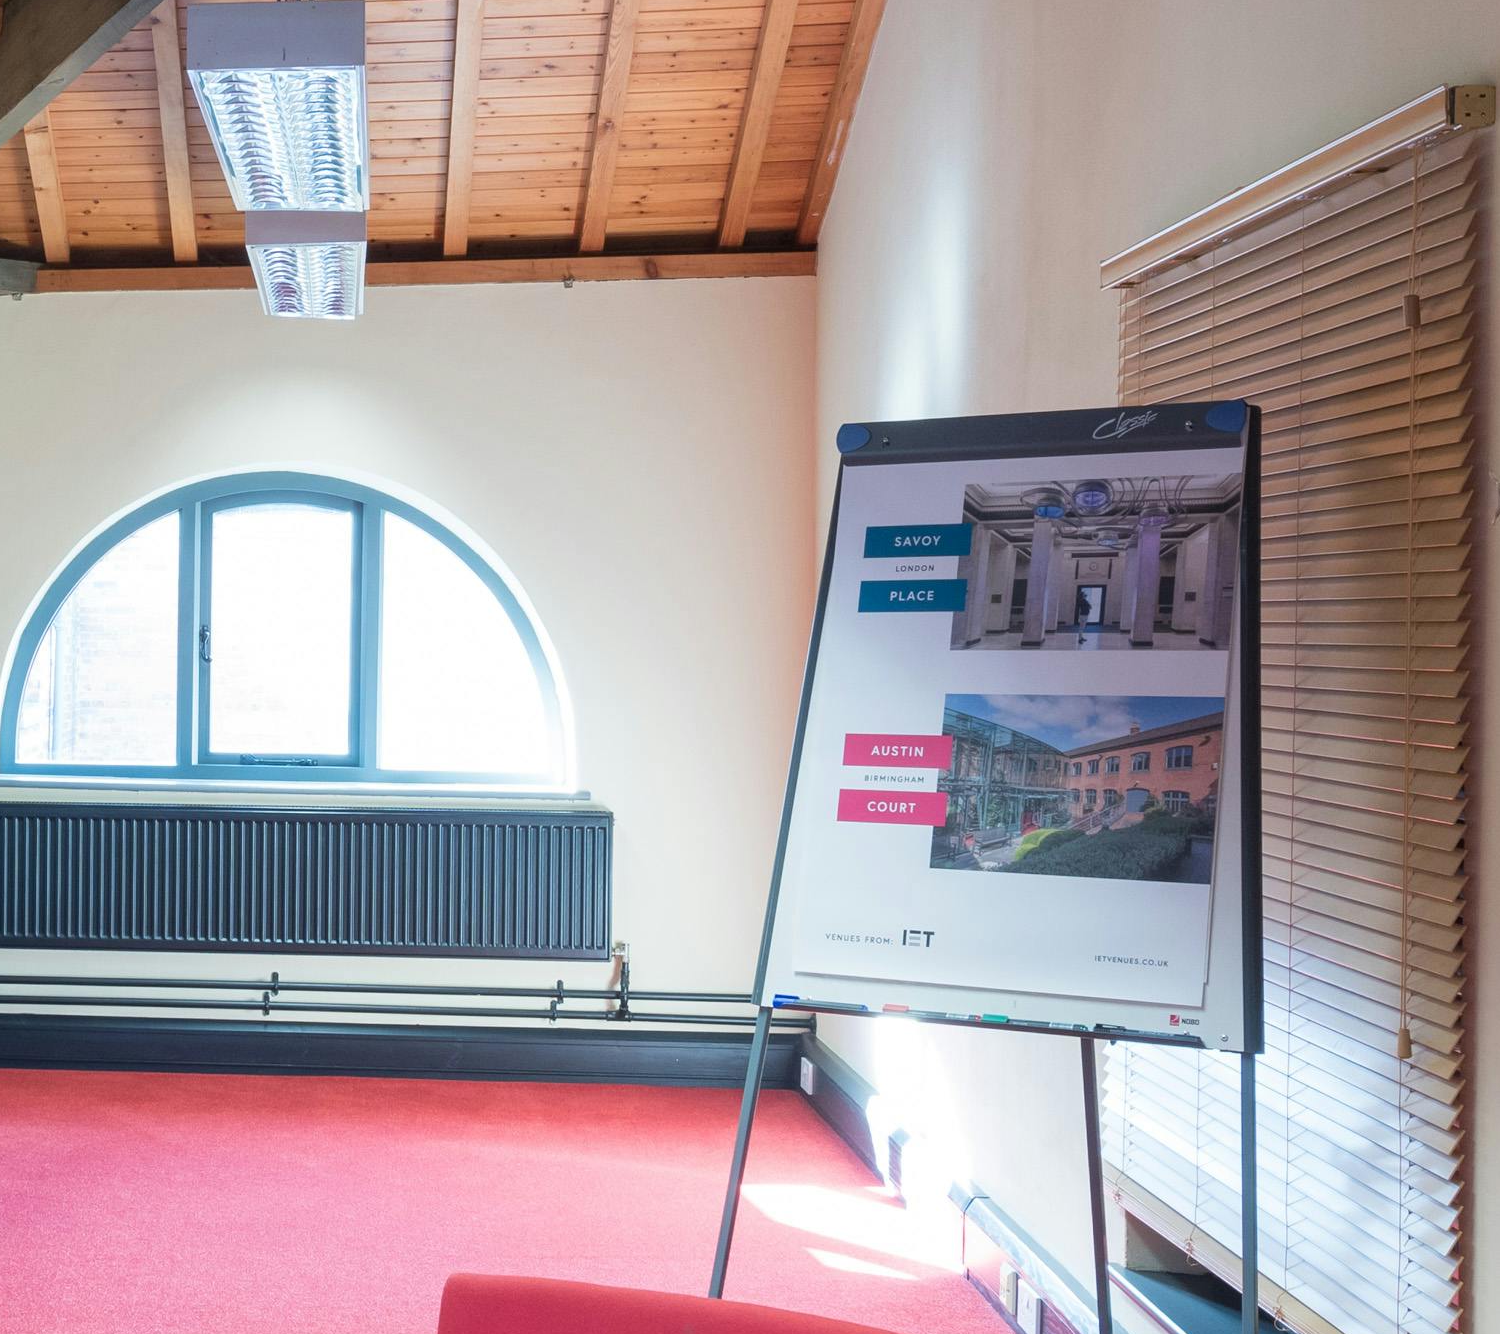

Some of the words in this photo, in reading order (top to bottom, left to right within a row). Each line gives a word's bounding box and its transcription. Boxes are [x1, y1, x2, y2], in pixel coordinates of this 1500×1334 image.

[1092, 410, 1159, 440] Classic
[894, 535, 941, 547] SAVOY
[895, 564, 935, 573] LONDON
[889, 590, 935, 602] PLACE
[870, 745, 924, 757] AUSTIN
[863, 774, 925, 784] BIRMINGHAM
[866, 801, 917, 813] COURT
[825, 932, 861, 943] VENUES
[864, 936, 894, 945] FROM:
[902, 929, 935, 948] IET
[1094, 955, 1169, 967] IETVENUES.CO.UK
